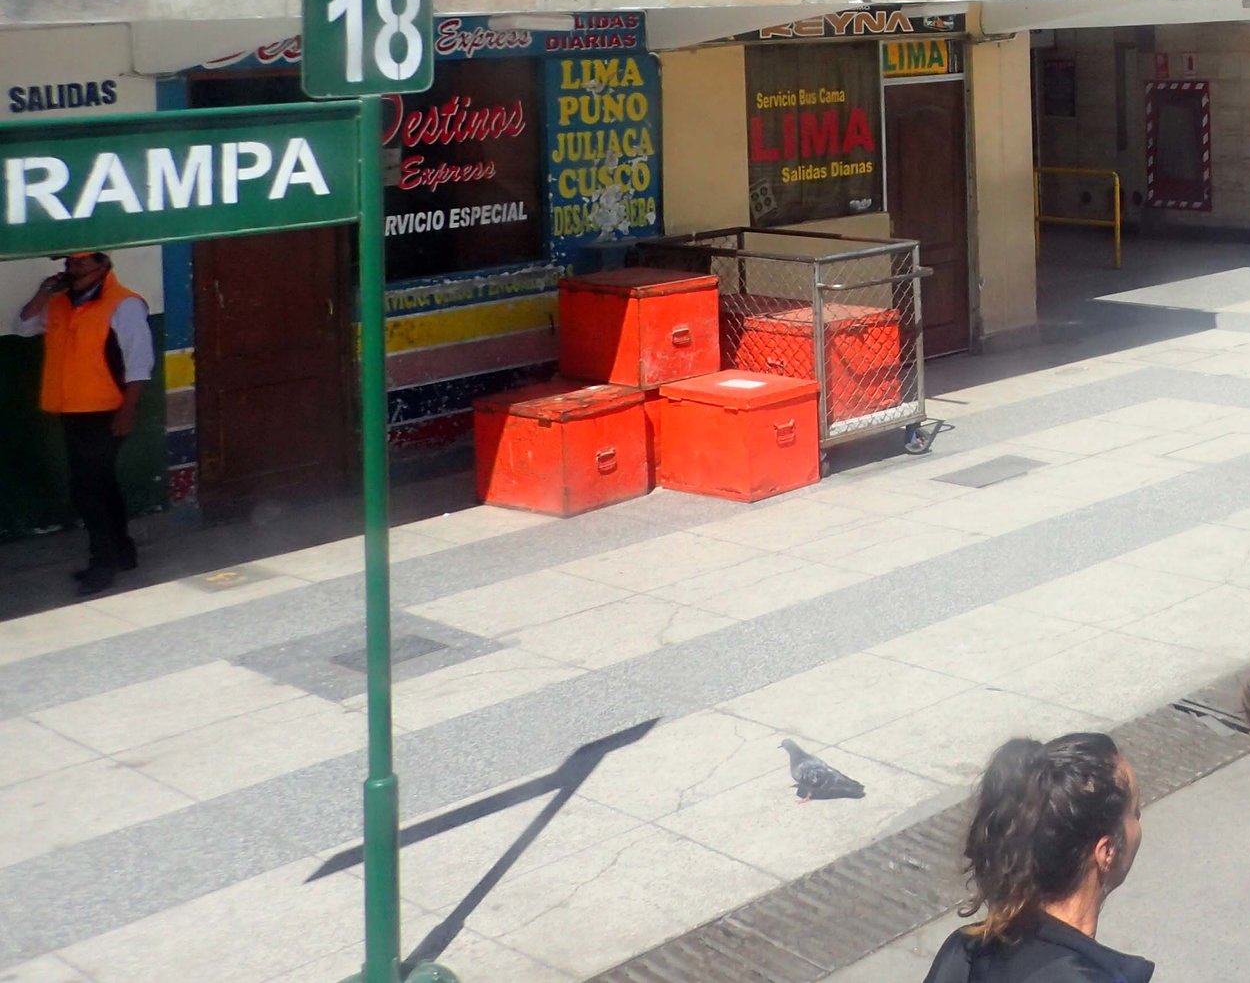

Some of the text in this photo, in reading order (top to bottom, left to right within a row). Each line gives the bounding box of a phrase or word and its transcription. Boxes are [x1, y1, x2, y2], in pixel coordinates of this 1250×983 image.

[436, 18, 533, 58] Express
[574, 13, 640, 30] LIDAS
[545, 33, 637, 51] DIARIAS
[882, 41, 945, 72] LIMA
[561, 58, 645, 90] LIMA
[9, 80, 118, 114] SALIDAS
[557, 93, 648, 126] PUNO
[756, 88, 845, 109] Servicio Bus Cama
[552, 128, 655, 164] JULIACA
[750, 106, 876, 162] LIMA
[5, 138, 331, 225] RAMPA
[400, 156, 497, 193] Express
[558, 163, 651, 199] CUSCO
[781, 164, 827, 184] Salidas
[384, 202, 528, 236] RVICIO ESPECIAL
